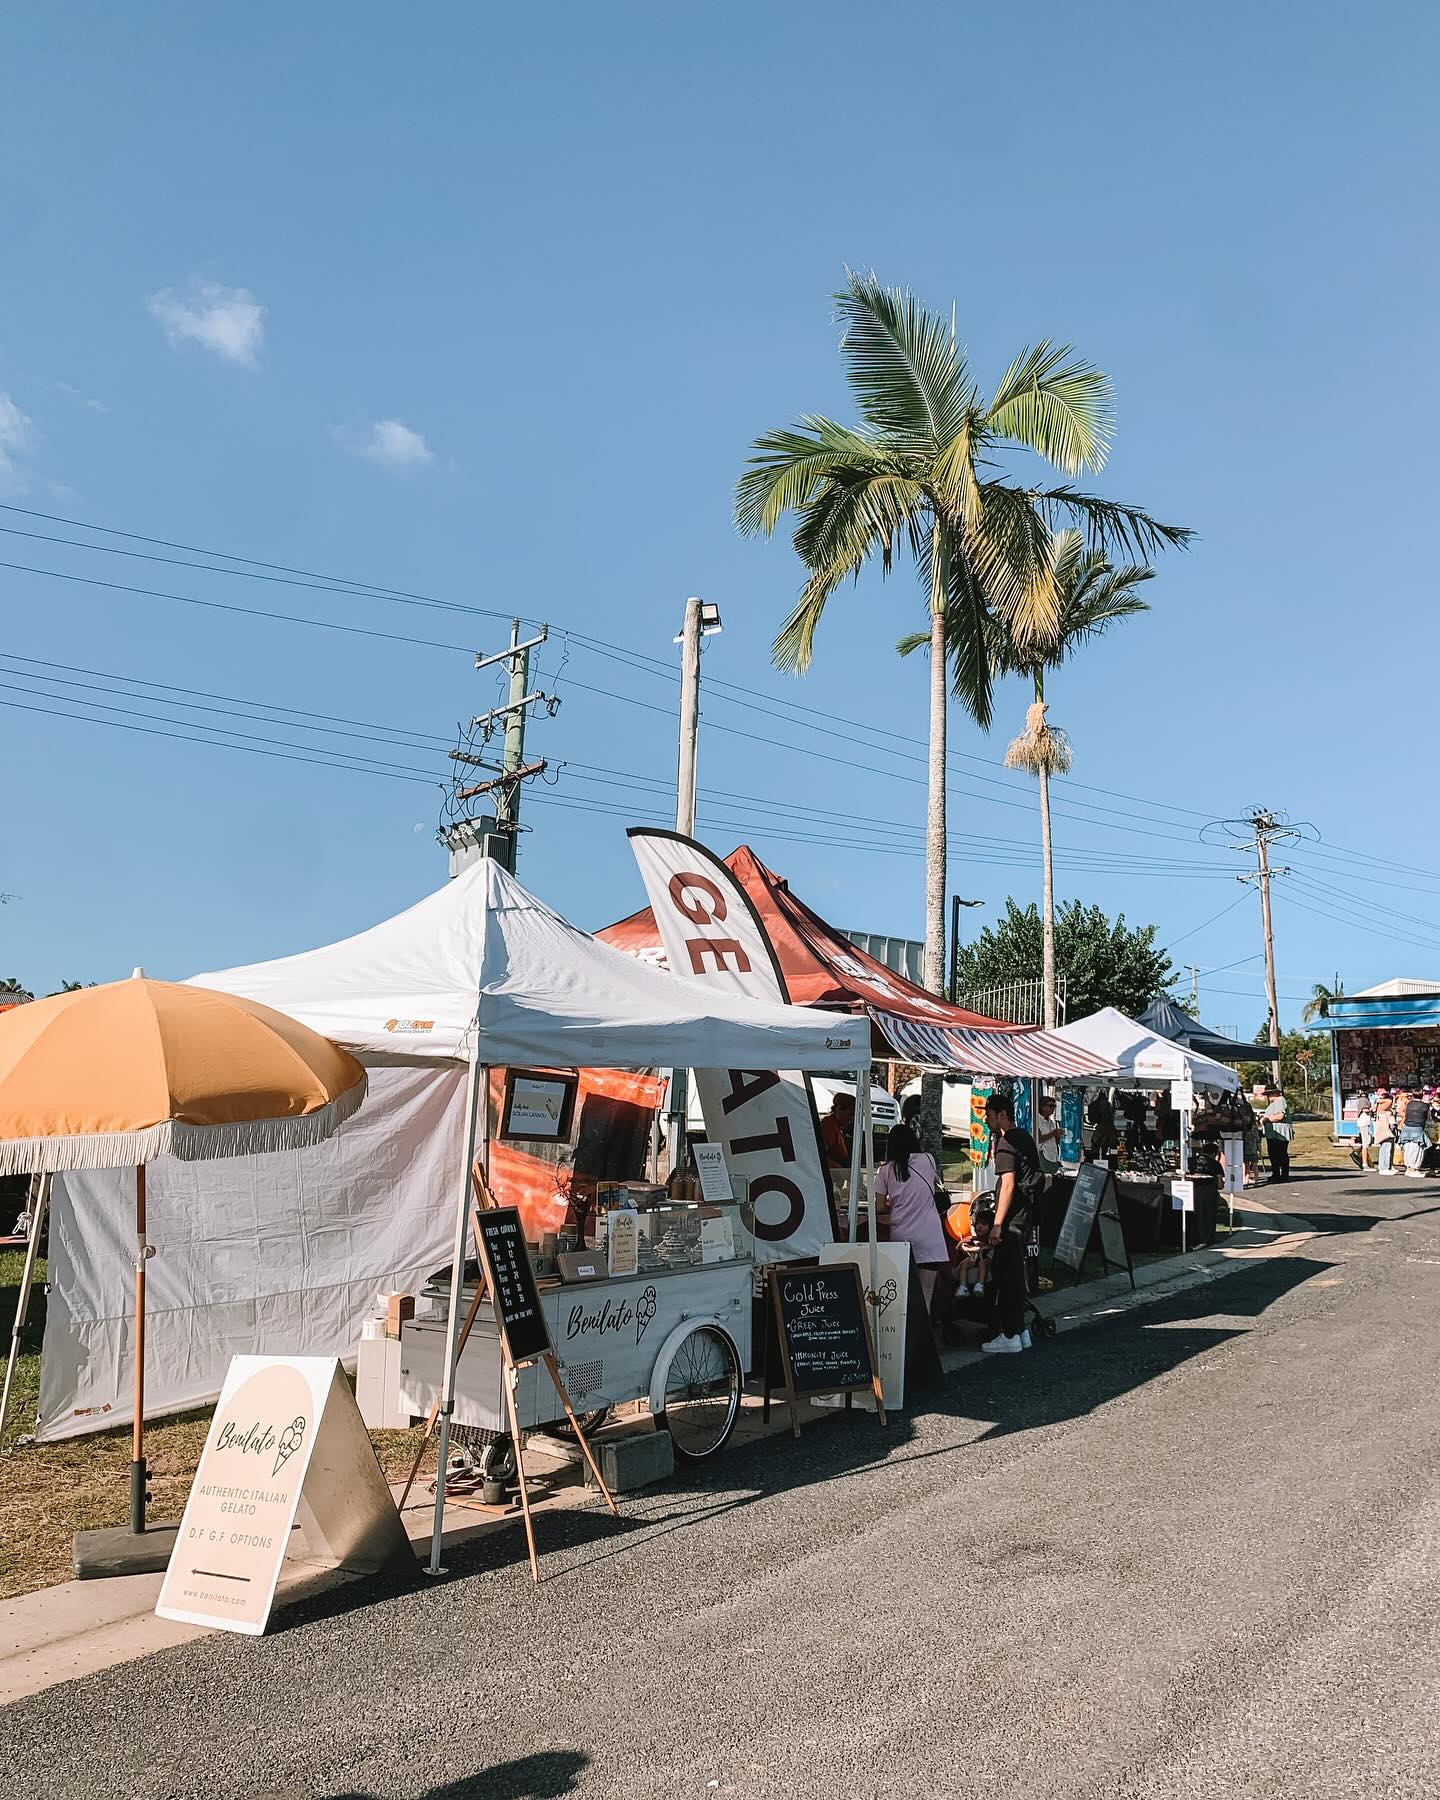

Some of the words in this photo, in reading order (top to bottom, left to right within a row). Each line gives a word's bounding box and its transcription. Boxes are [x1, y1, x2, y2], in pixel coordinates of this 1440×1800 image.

[485, 1226, 500, 1237] FRESH
[783, 1281, 815, 1302] Cold
[815, 1280, 839, 1301] Press
[800, 1303, 825, 1316] Juice
[566, 1298, 634, 1341] Benilato
[216, 1420, 276, 1455] Benilato
[199, 1484, 250, 1500] AUTHENTIC
[250, 1490, 288, 1504] ITALIAN
[220, 1501, 257, 1516] GELATO
[230, 1533, 273, 1549] OPTIONS
[183, 1588, 247, 1606] www.benilato.com
